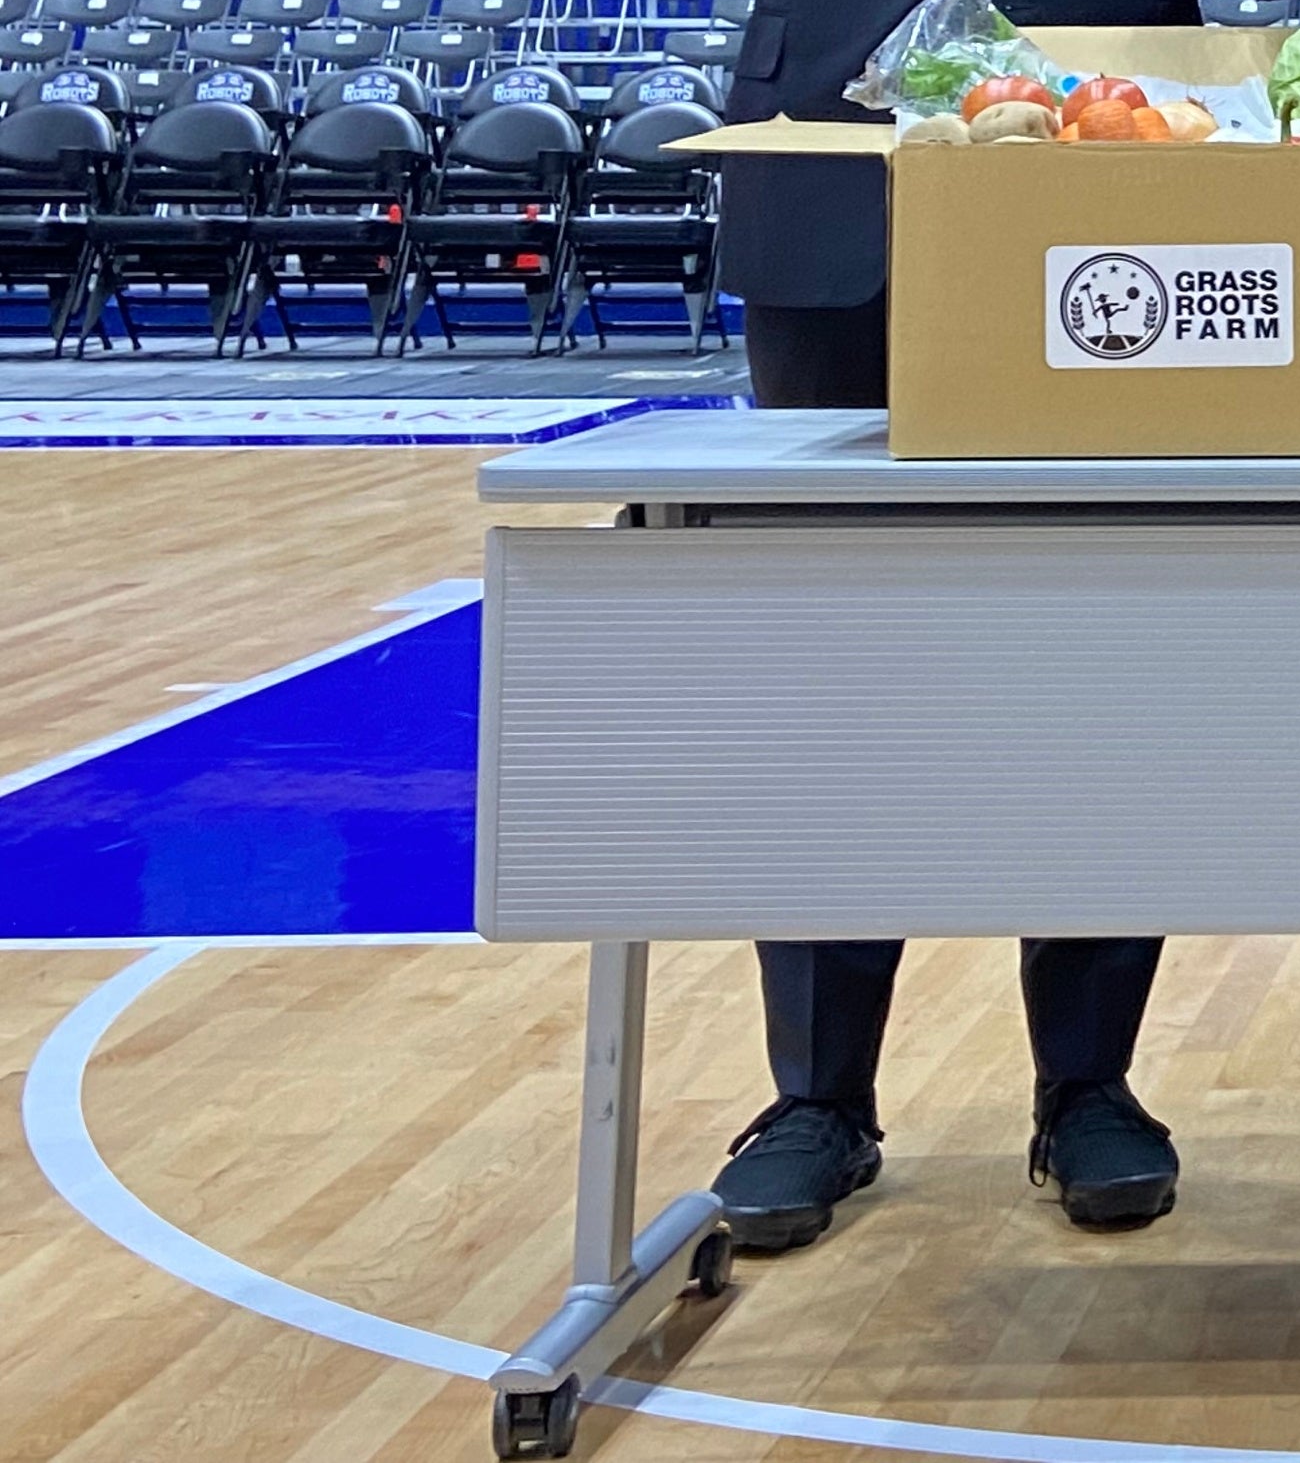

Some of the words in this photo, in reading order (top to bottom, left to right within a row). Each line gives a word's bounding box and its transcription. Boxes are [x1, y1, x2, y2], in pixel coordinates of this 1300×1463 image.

[1175, 270, 1278, 292] GRASS
[1176, 294, 1279, 316] ROOTS
[1176, 318, 1279, 340] FARM
